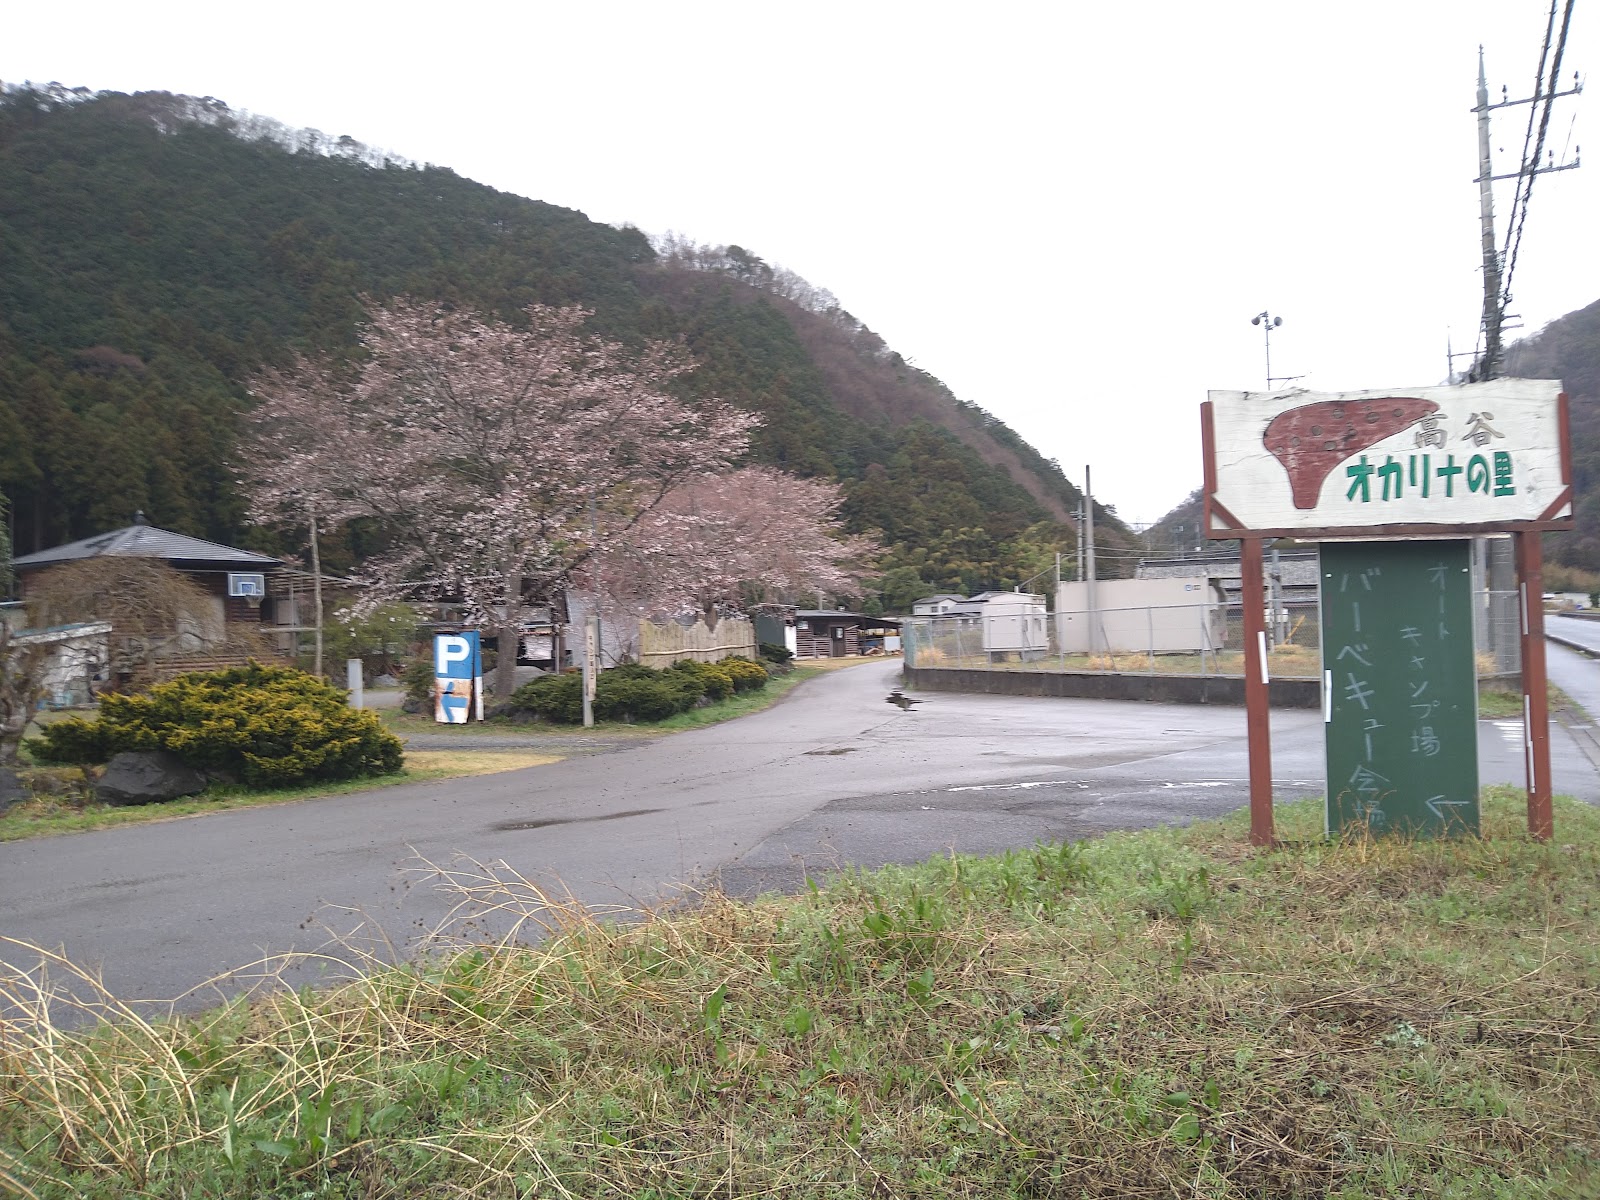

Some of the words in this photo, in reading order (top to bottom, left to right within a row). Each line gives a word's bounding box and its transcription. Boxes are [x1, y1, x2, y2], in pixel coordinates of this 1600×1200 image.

[1415, 410, 1506, 449] 高谷
[1346, 451, 1517, 503] オカリナの里
[437, 635, 470, 674] P
[1399, 625, 1441, 757] キャンプ場
